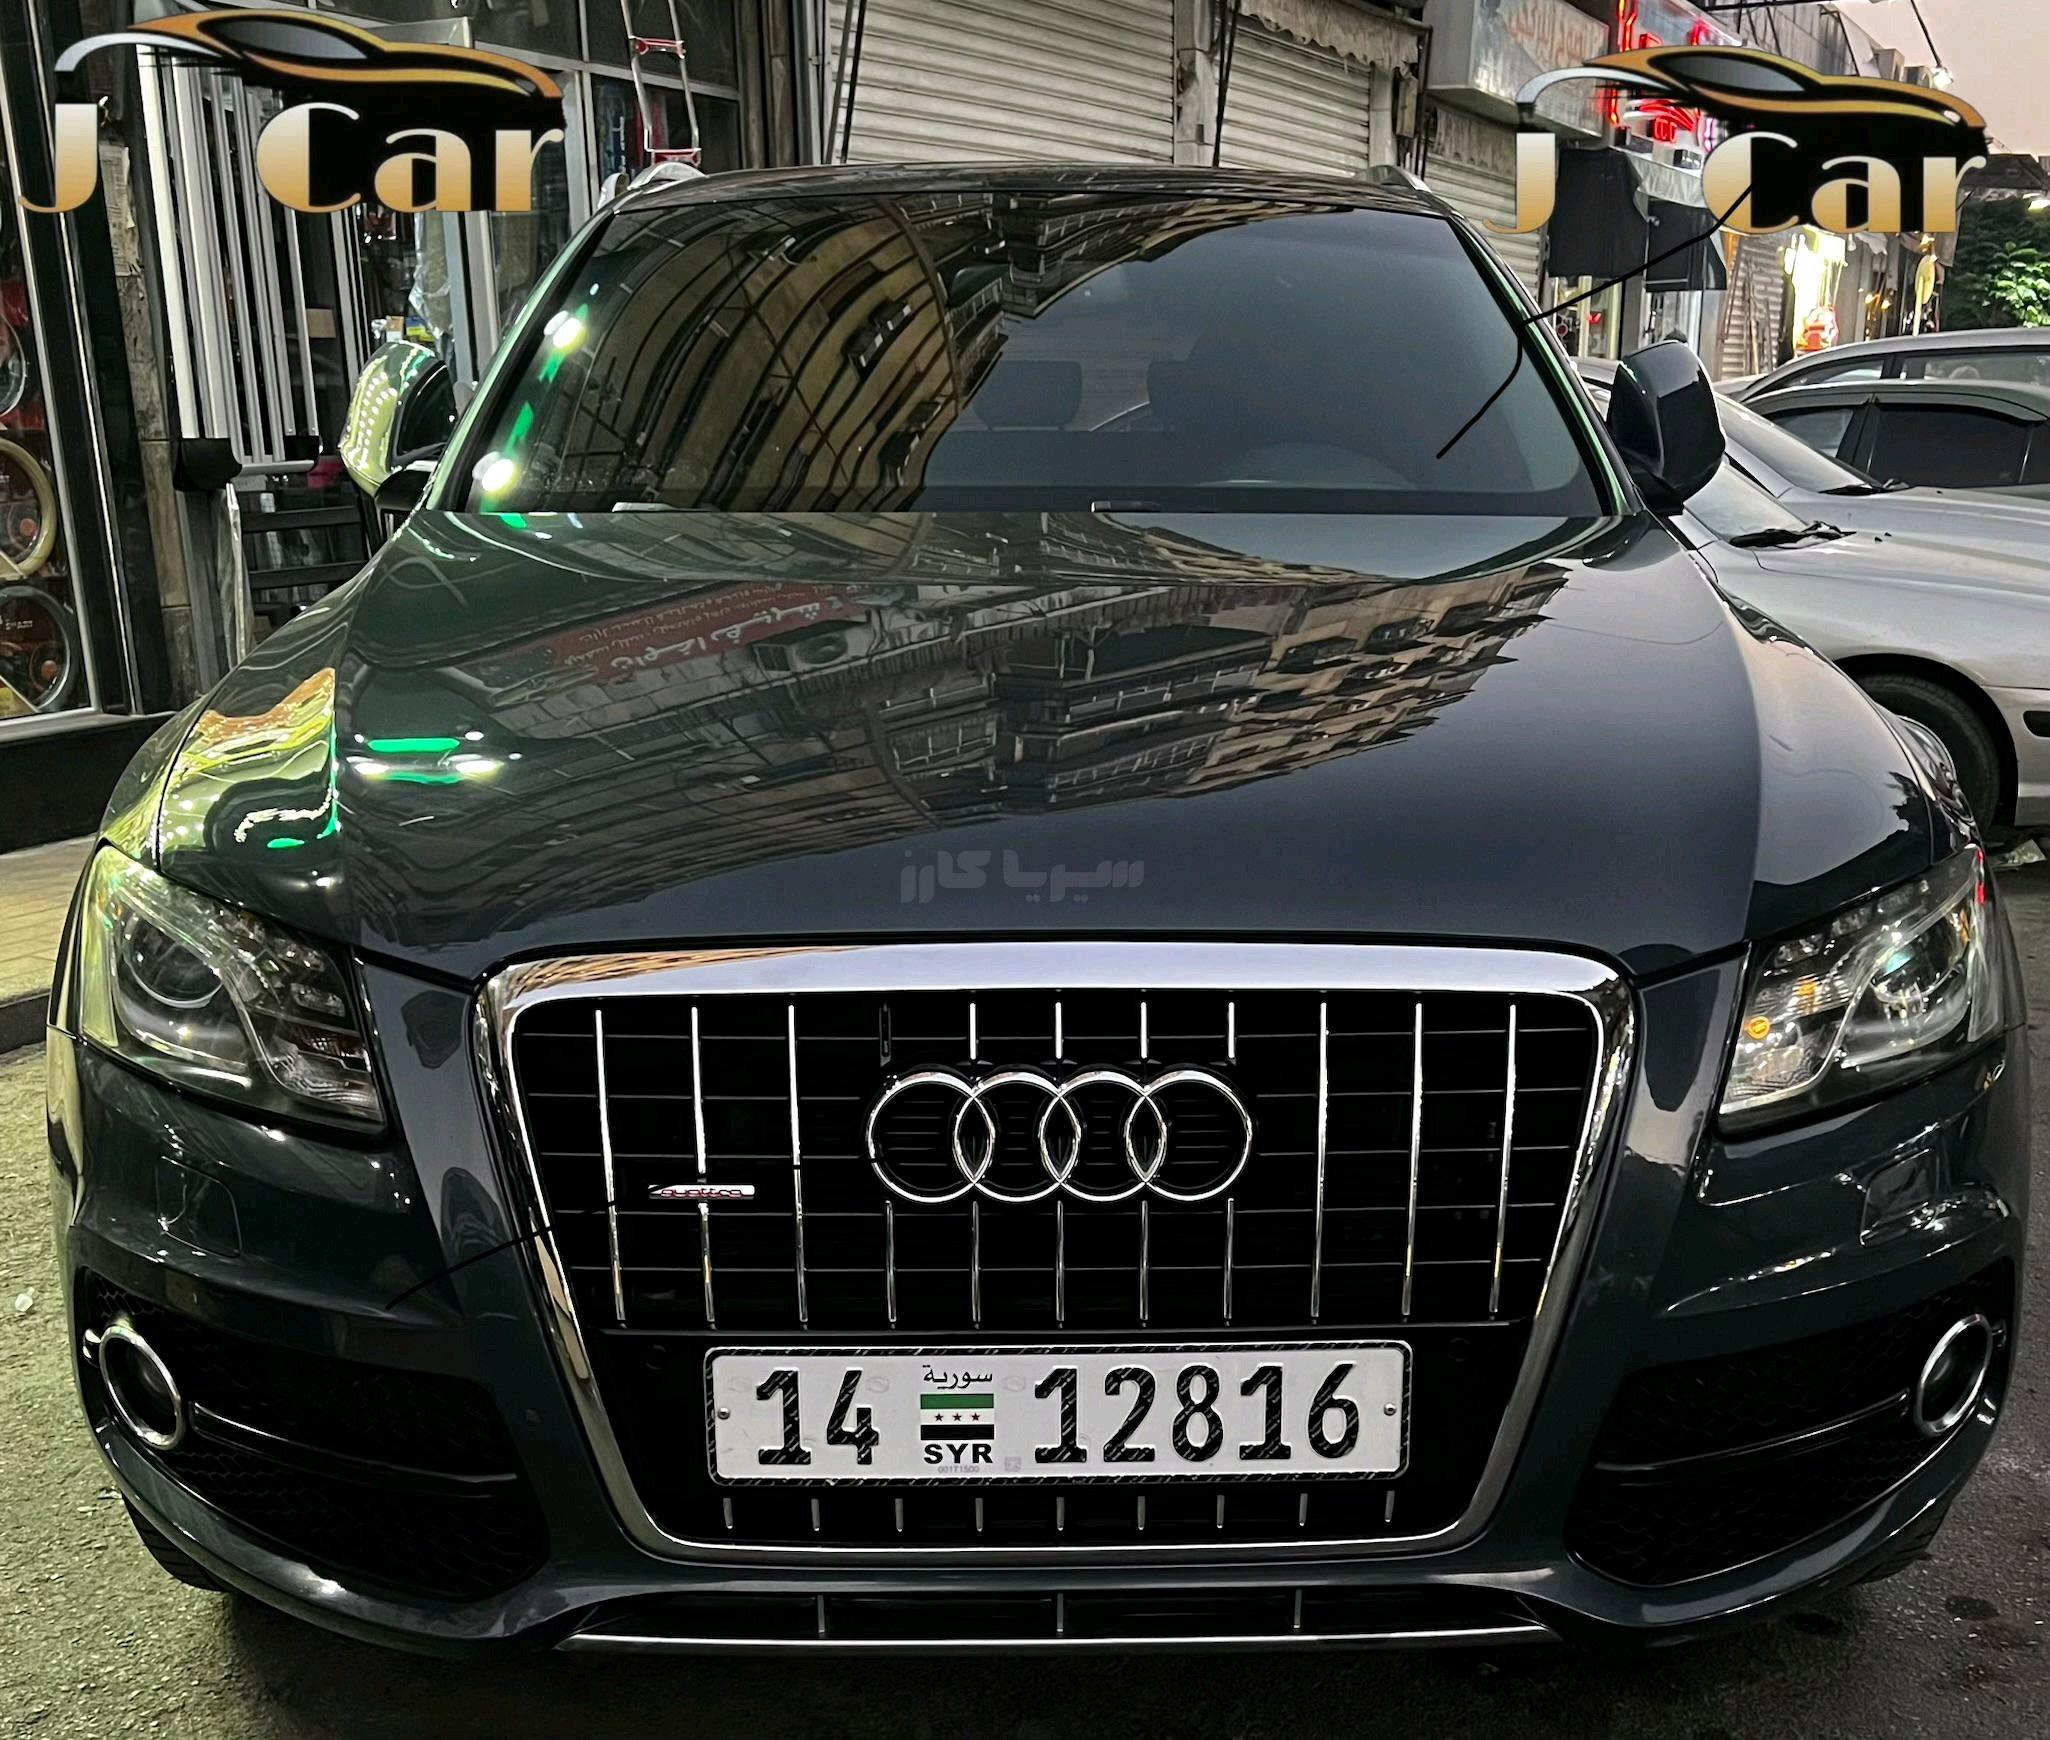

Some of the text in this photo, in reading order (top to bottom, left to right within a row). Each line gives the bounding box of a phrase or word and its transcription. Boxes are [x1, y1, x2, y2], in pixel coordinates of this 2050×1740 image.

[922, 1364, 993, 1390] سورية
[756, 1363, 1360, 1465] 14 12816
[923, 1443, 993, 1465] SYR
